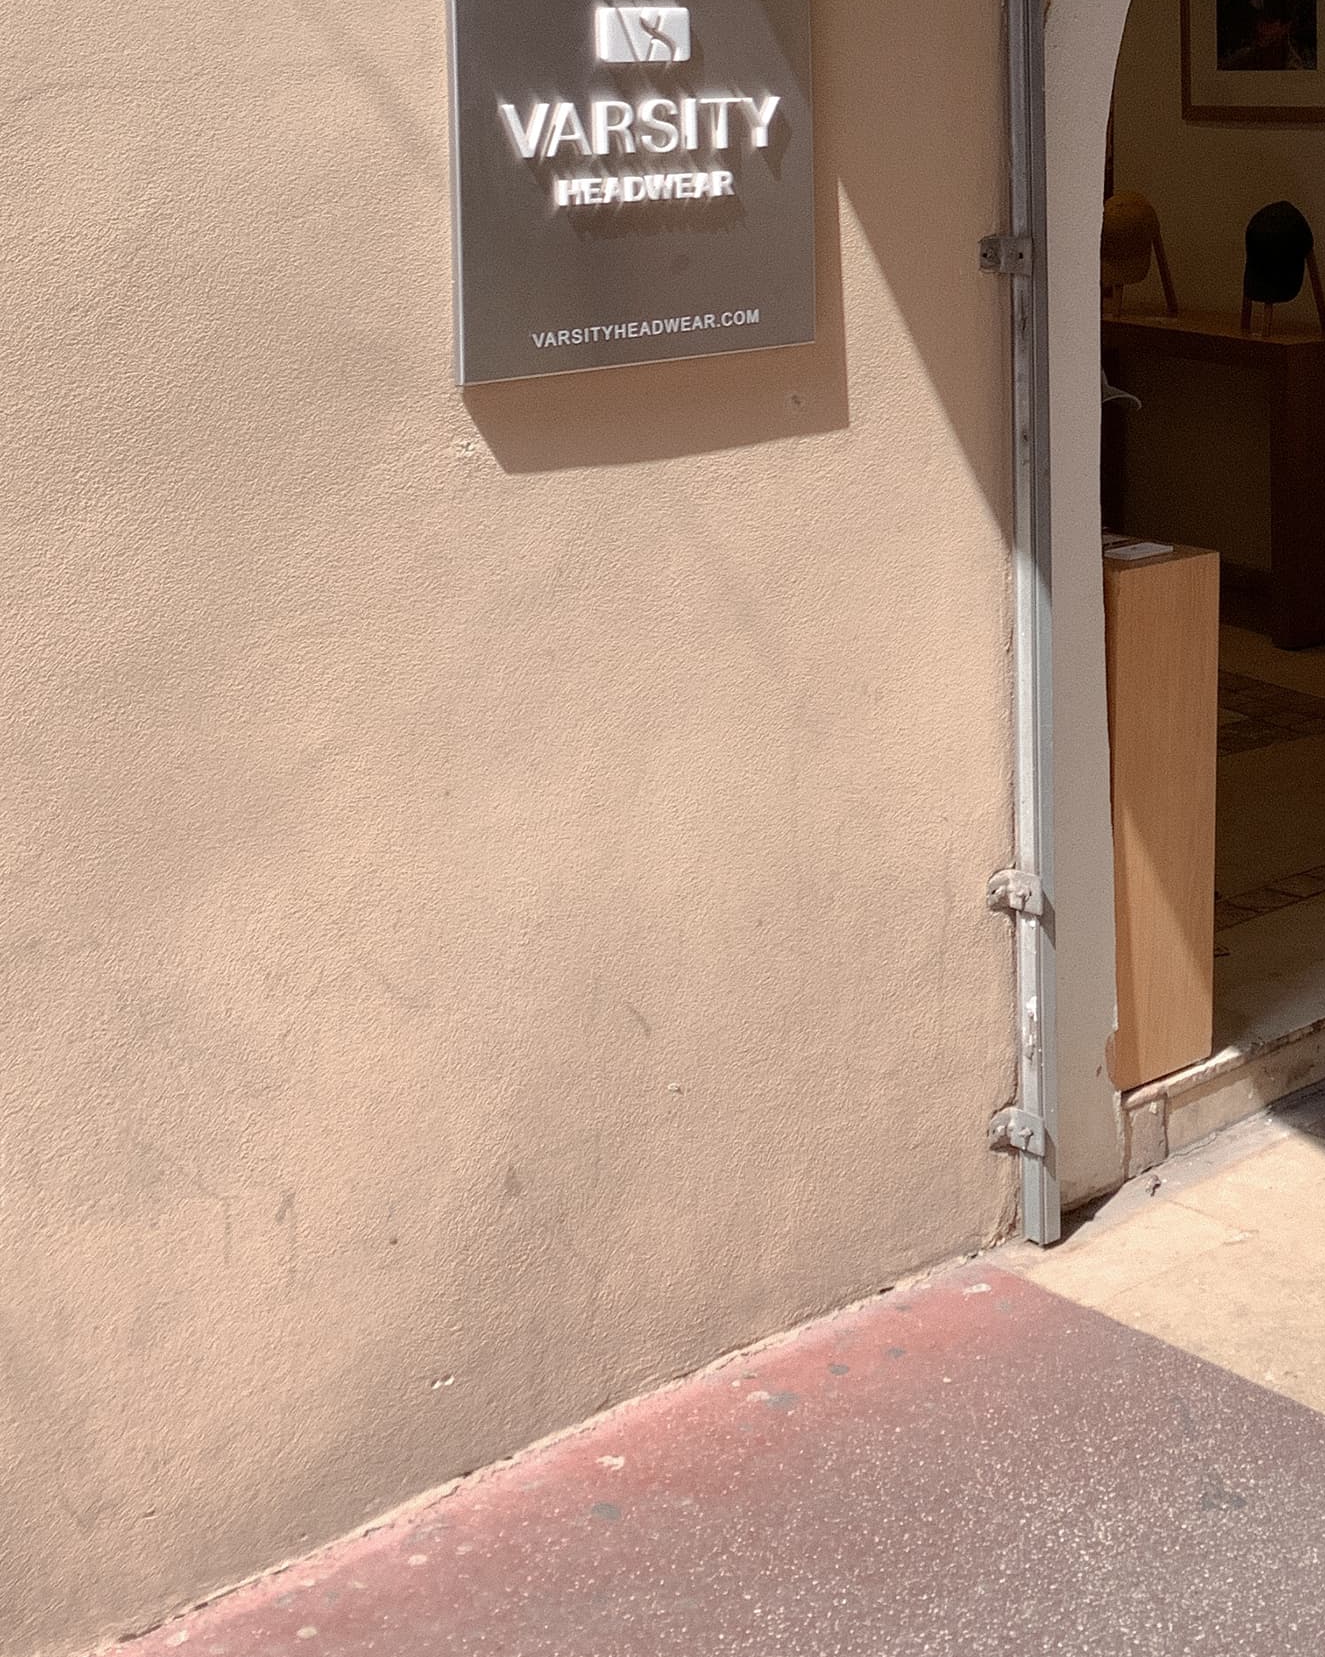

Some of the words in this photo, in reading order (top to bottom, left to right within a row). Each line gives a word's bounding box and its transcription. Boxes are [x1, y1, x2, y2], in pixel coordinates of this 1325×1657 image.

[500, 96, 780, 159] VARSITY
[556, 170, 735, 206] HEADWEAR
[532, 309, 760, 348] VARSITYHEADWEAR.COM
